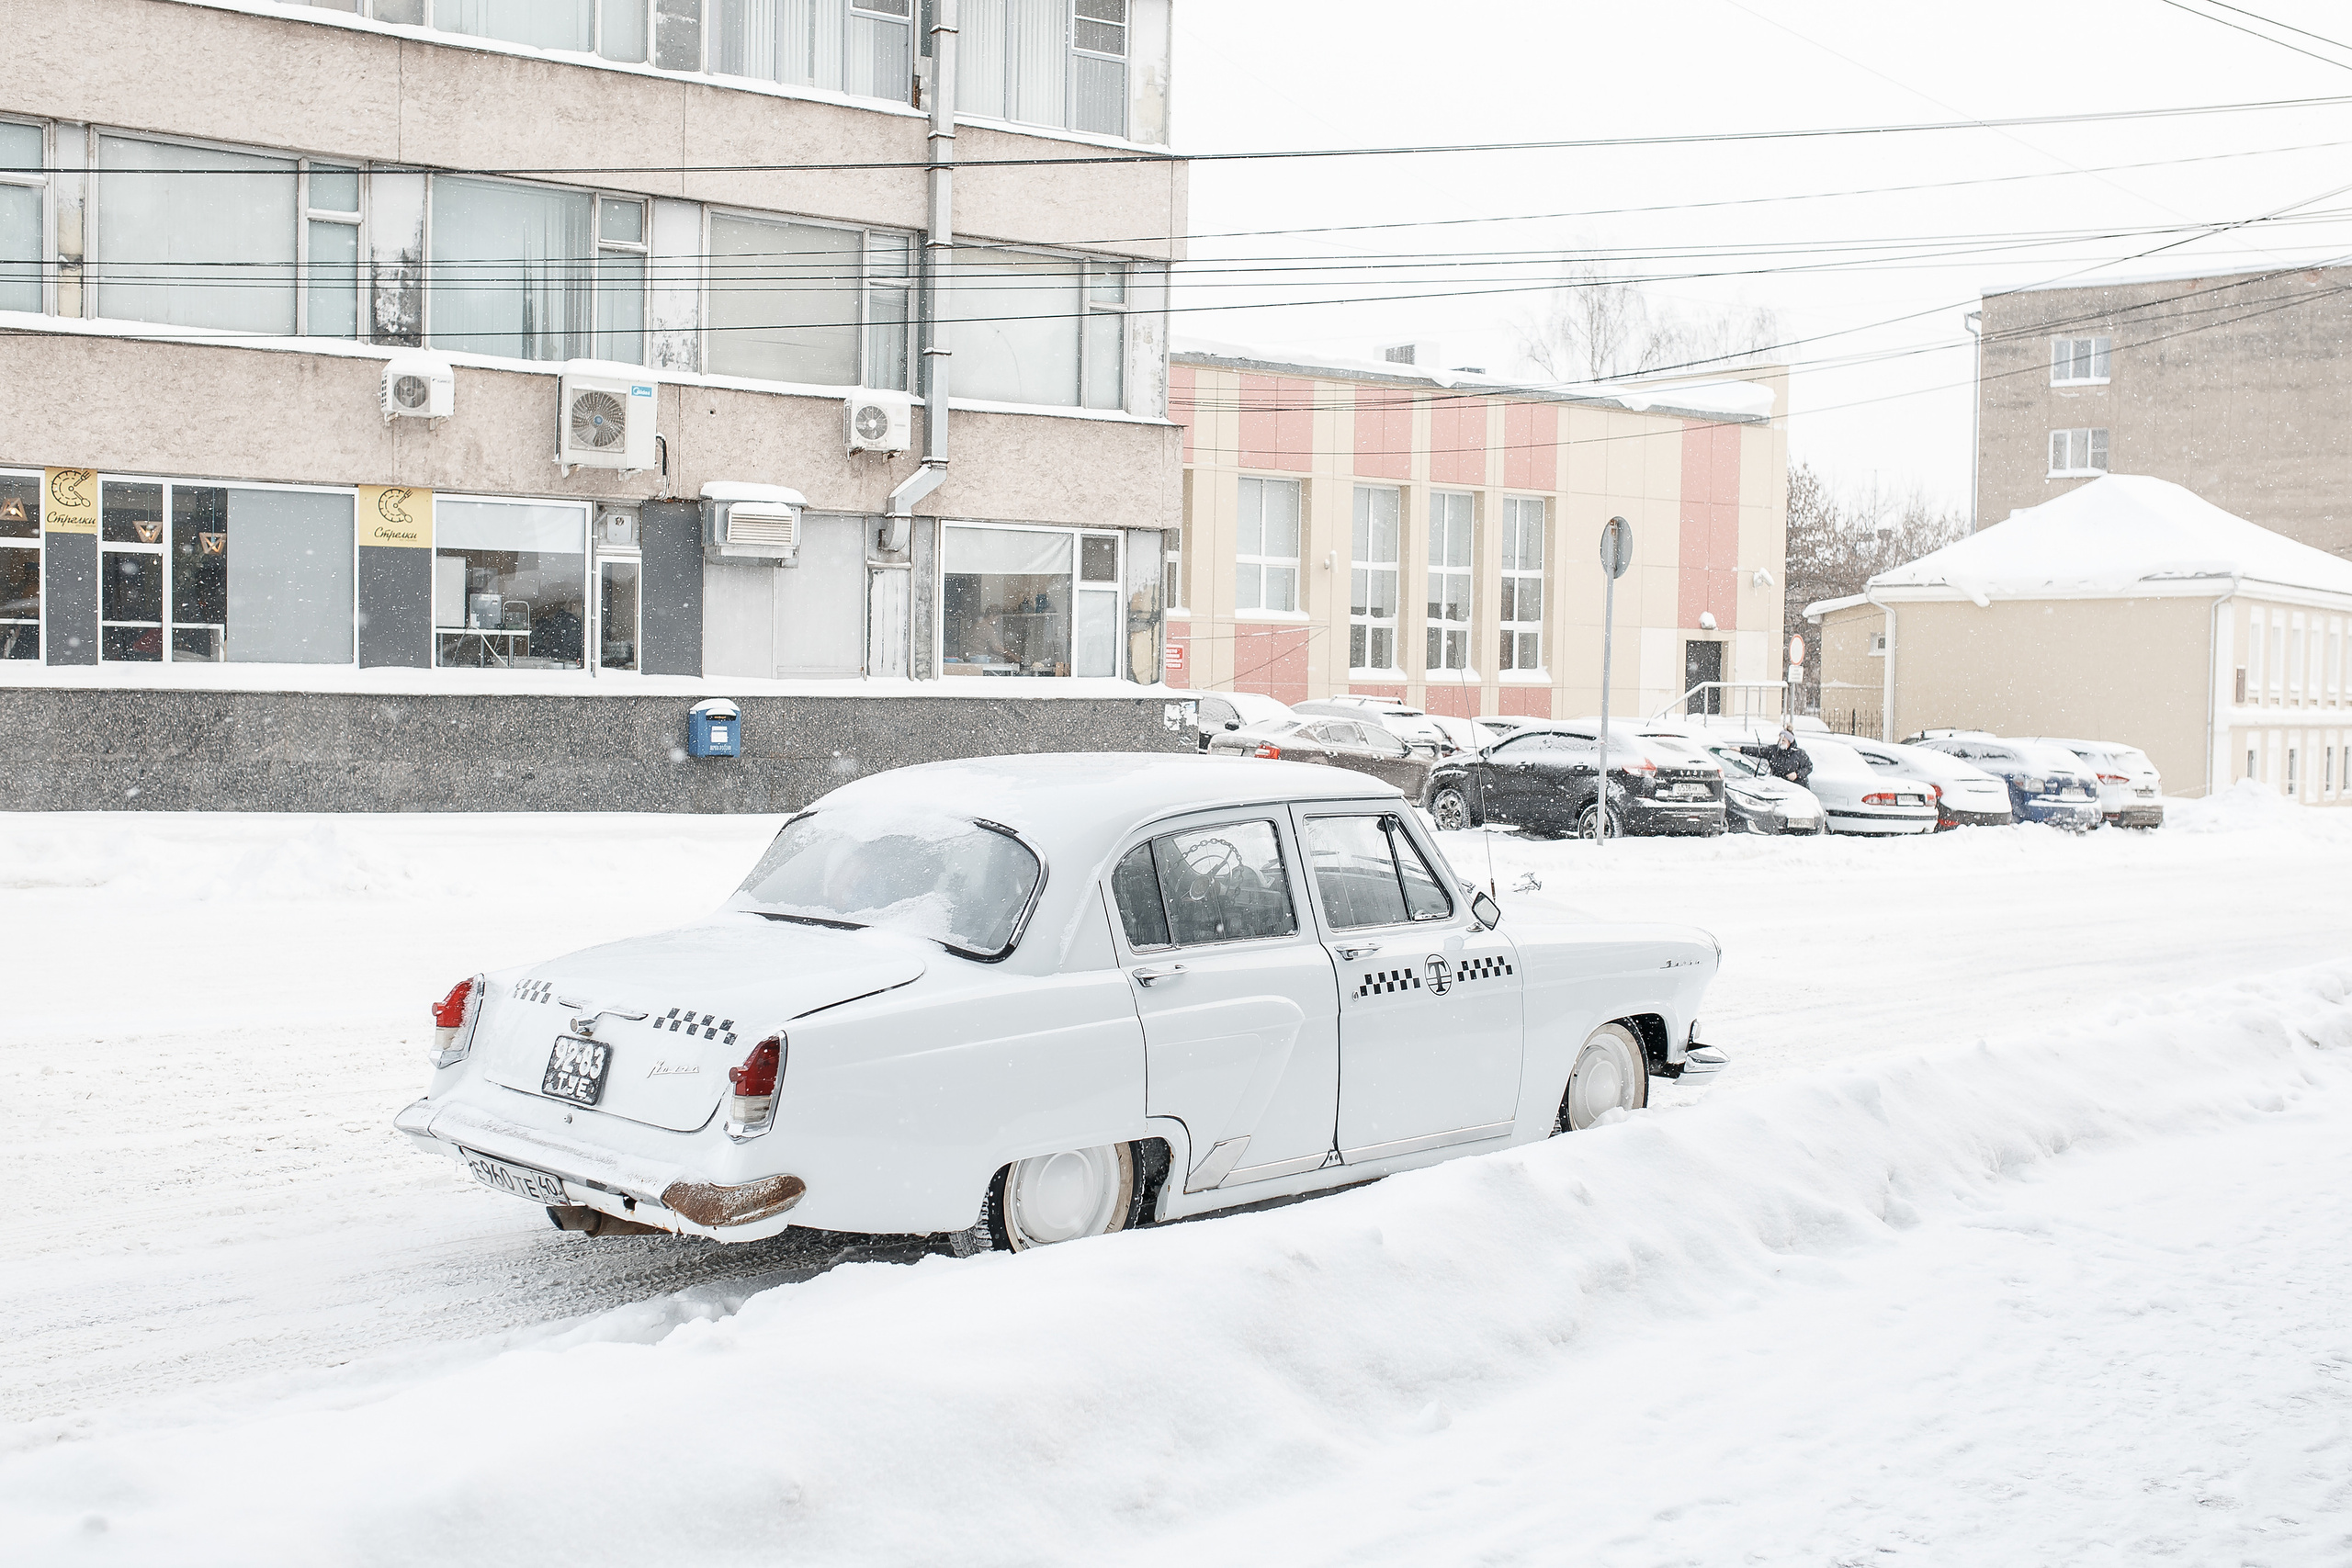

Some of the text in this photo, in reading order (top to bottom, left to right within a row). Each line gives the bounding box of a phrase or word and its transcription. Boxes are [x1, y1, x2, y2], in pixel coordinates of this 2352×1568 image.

[47, 511, 96, 526] Стрелки
[374, 526, 417, 541] Стрелки
[553, 1037, 605, 1079] 92-83
